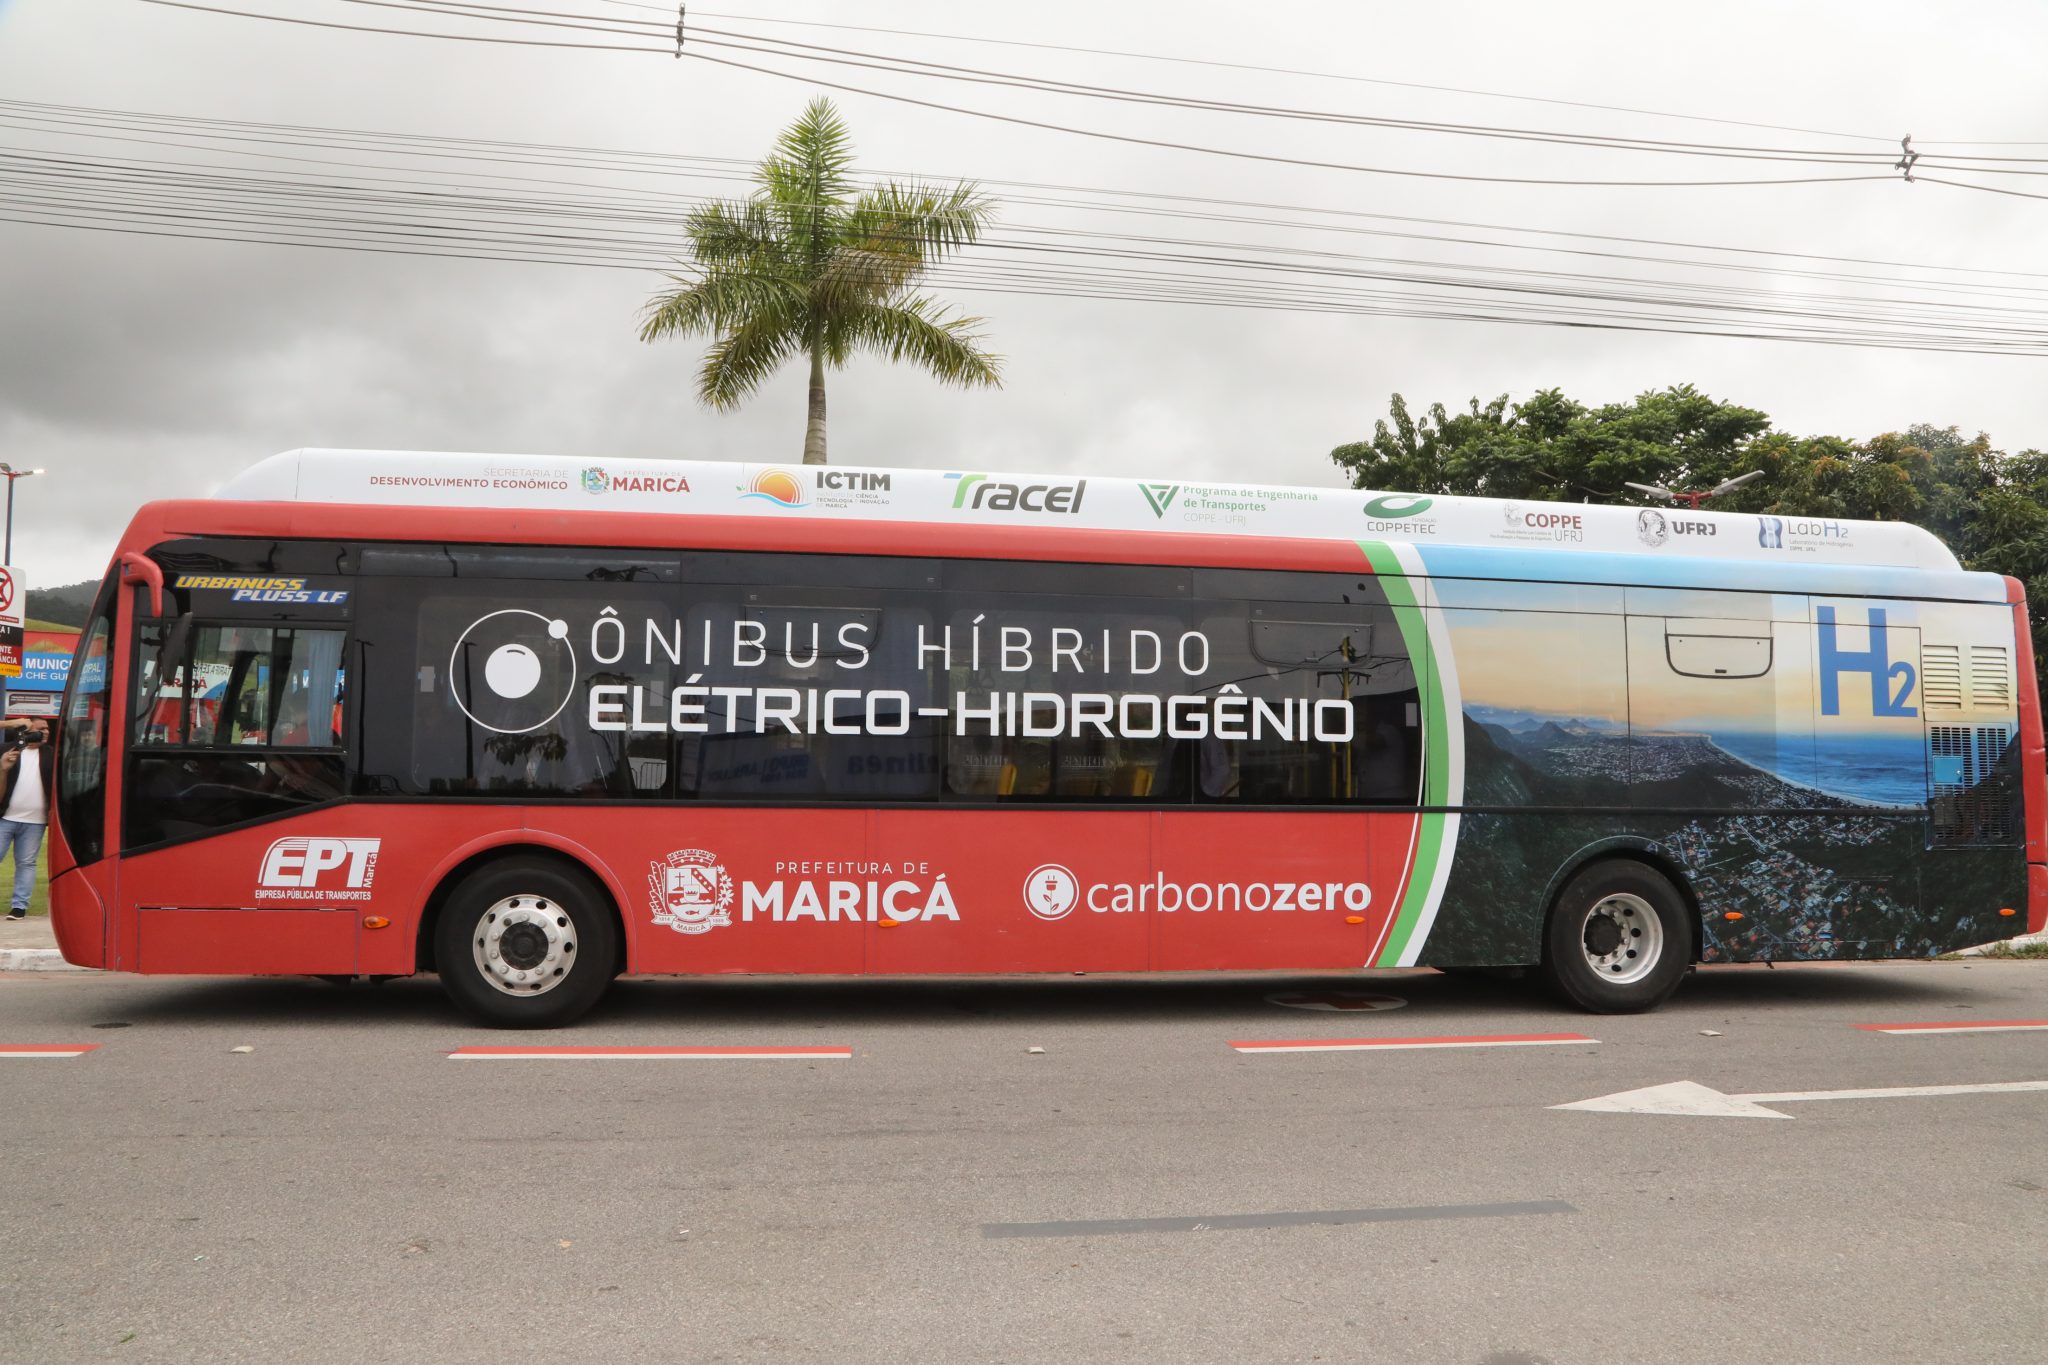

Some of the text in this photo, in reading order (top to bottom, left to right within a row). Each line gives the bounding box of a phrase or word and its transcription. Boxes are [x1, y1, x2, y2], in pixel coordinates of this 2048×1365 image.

[484, 467, 568, 479] SECRETARIA DE
[370, 476, 568, 490] DESENVOLVIMENTO ECONÔMICO
[612, 476, 690, 492] MARICÁ
[817, 471, 891, 492] ICTIM
[943, 473, 1087, 514] Tracel
[1183, 485, 1318, 502] Programa de Engenharia
[1183, 498, 1266, 512] de Transportes
[1184, 513, 1216, 523] COPPE
[1225, 515, 1246, 526] UFRJ
[1524, 513, 1582, 529] COPPE
[1367, 521, 1436, 534] COPPETEC
[1671, 521, 1716, 536] UFRJ
[1787, 518, 1849, 538] LabH2
[1554, 529, 1583, 543] UFRJ
[175, 576, 307, 591] URBANUSS
[233, 589, 348, 603] PLUSS LF
[591, 606, 1210, 676] ÔNIBUS HÍBRIDO
[25, 671, 48, 681] CHE
[261, 838, 382, 888] EPT
[362, 852, 378, 888] Maricá
[776, 861, 928, 875] PREFEITURA DE
[255, 888, 371, 900] EMPRESA PÚBLICA DE TRANSPORTES
[742, 873, 960, 922] MARICÁ
[1087, 871, 1372, 913] carbonozero
